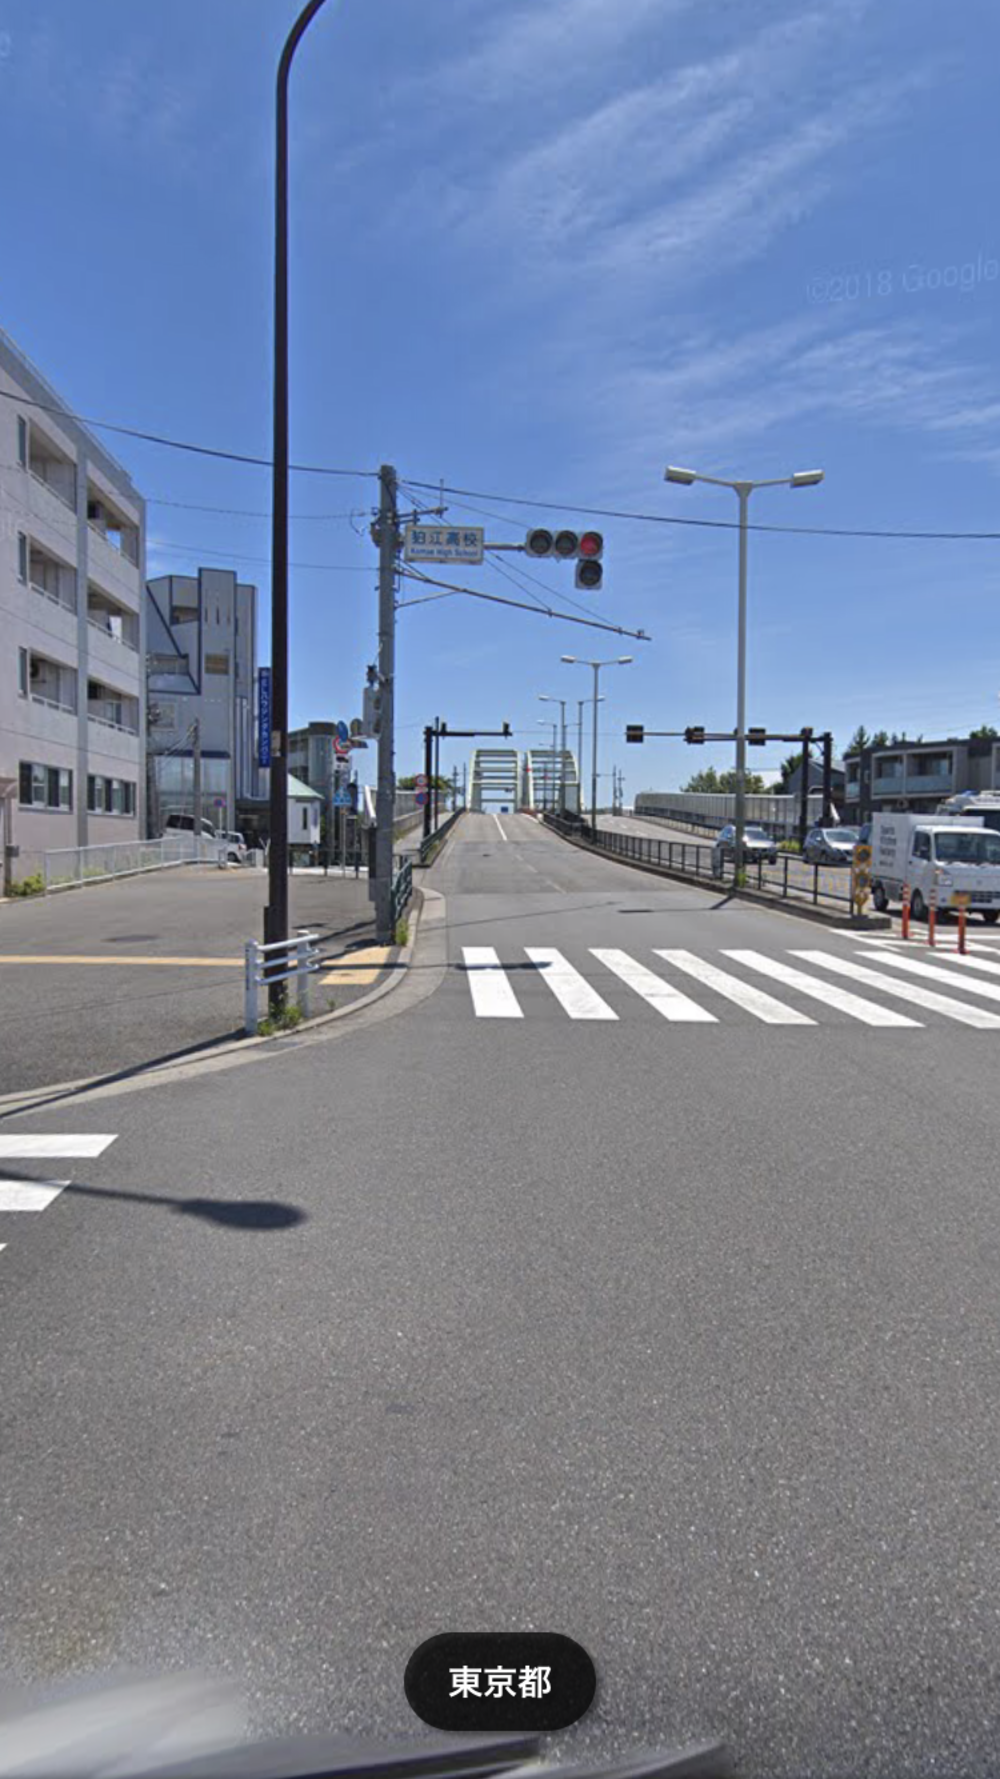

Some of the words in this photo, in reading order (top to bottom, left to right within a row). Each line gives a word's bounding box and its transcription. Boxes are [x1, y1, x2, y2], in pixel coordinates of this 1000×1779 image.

[411, 529, 478, 547] 狛江高校
[436, 548, 453, 558] High
[454, 548, 478, 557] School
